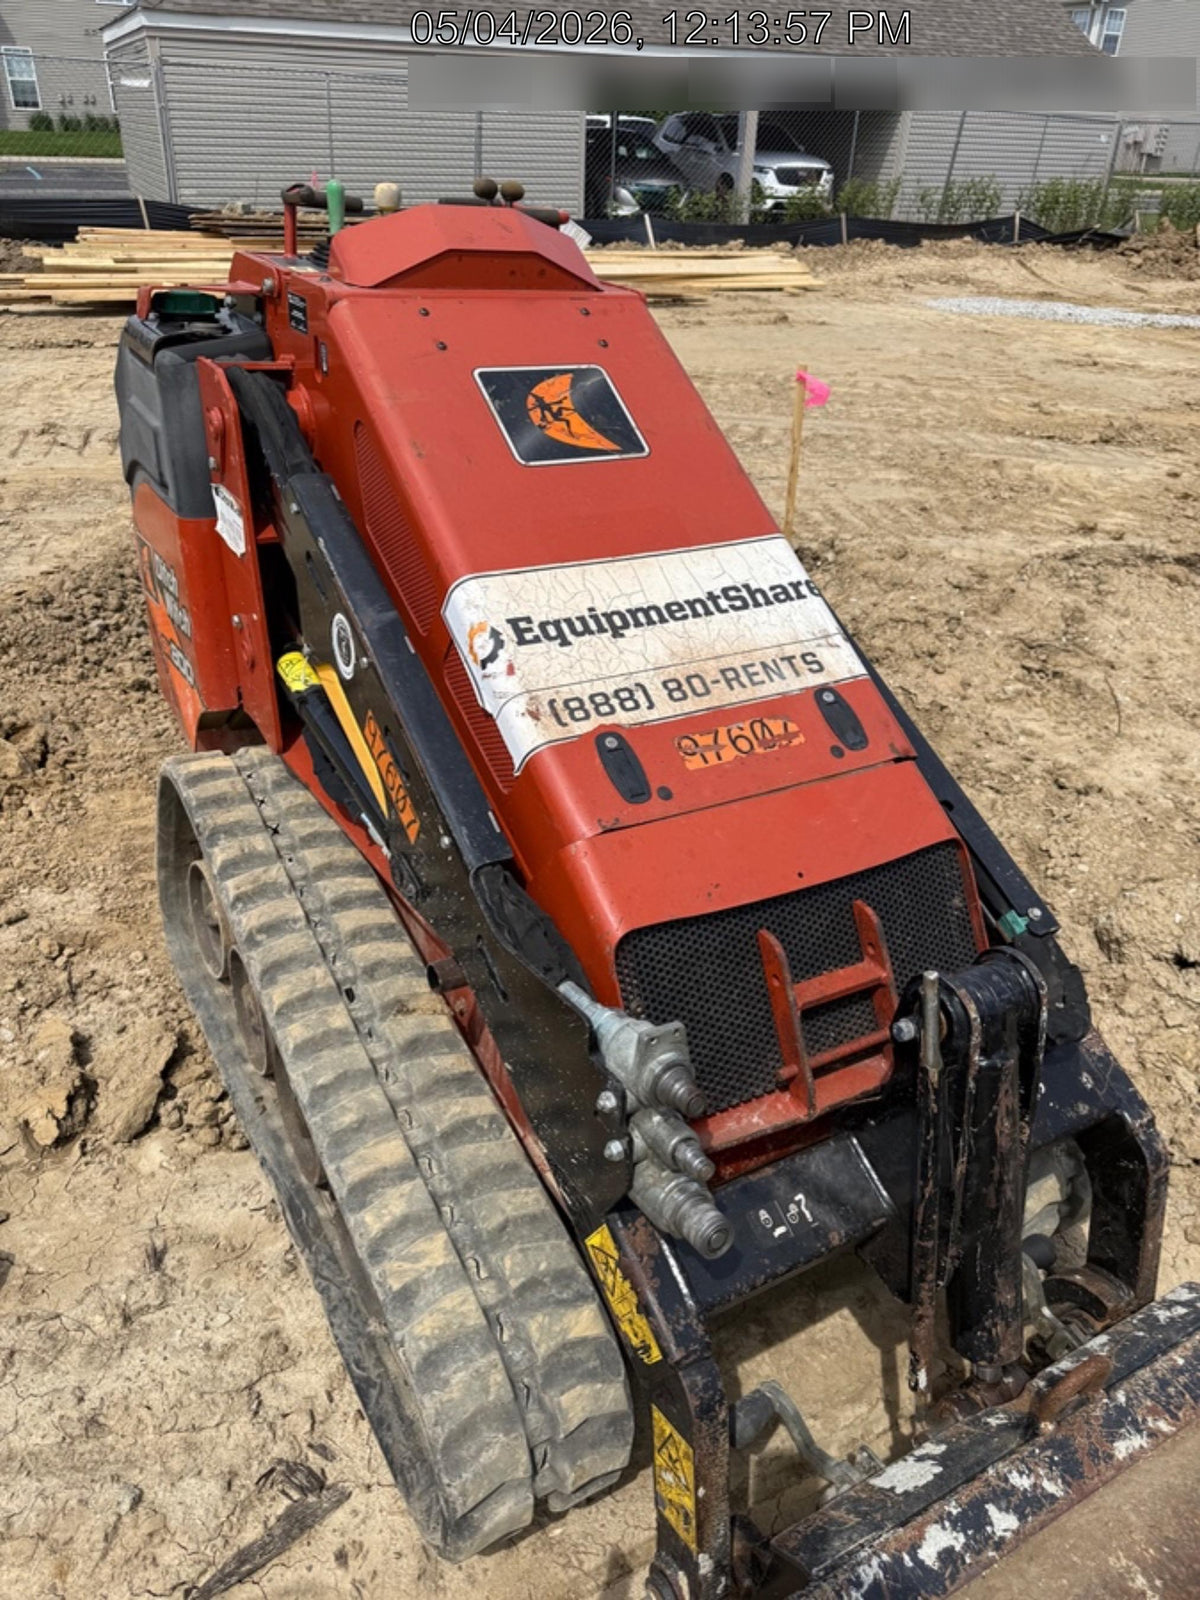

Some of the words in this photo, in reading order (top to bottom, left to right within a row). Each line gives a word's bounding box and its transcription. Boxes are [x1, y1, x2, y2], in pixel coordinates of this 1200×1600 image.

[506, 579, 820, 648] EquipmentShare
[547, 682, 655, 728] (888)
[661, 651, 825, 706] 80-RENTS
